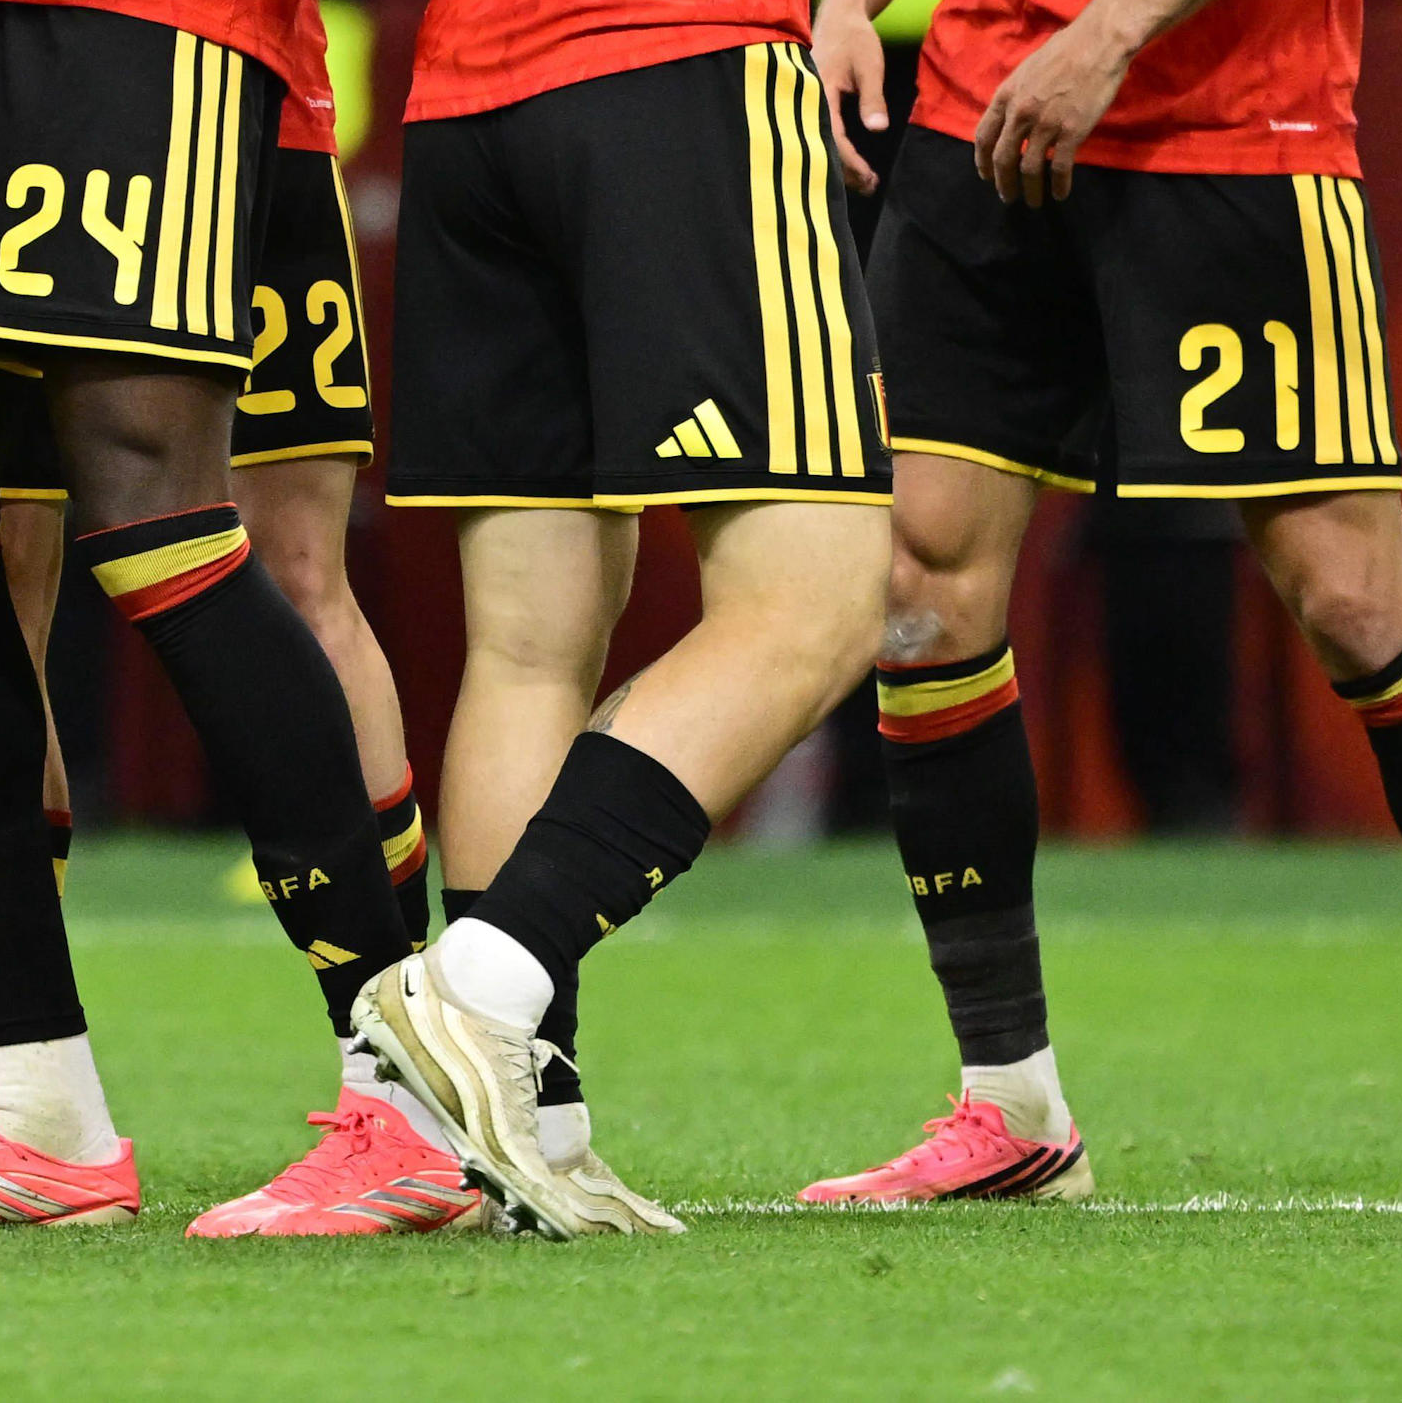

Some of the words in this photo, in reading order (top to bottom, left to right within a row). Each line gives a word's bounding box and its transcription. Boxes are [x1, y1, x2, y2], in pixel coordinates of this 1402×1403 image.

[236, 279, 367, 415] 22
[1179, 320, 1300, 453] 21
[905, 867, 982, 895] BFA
